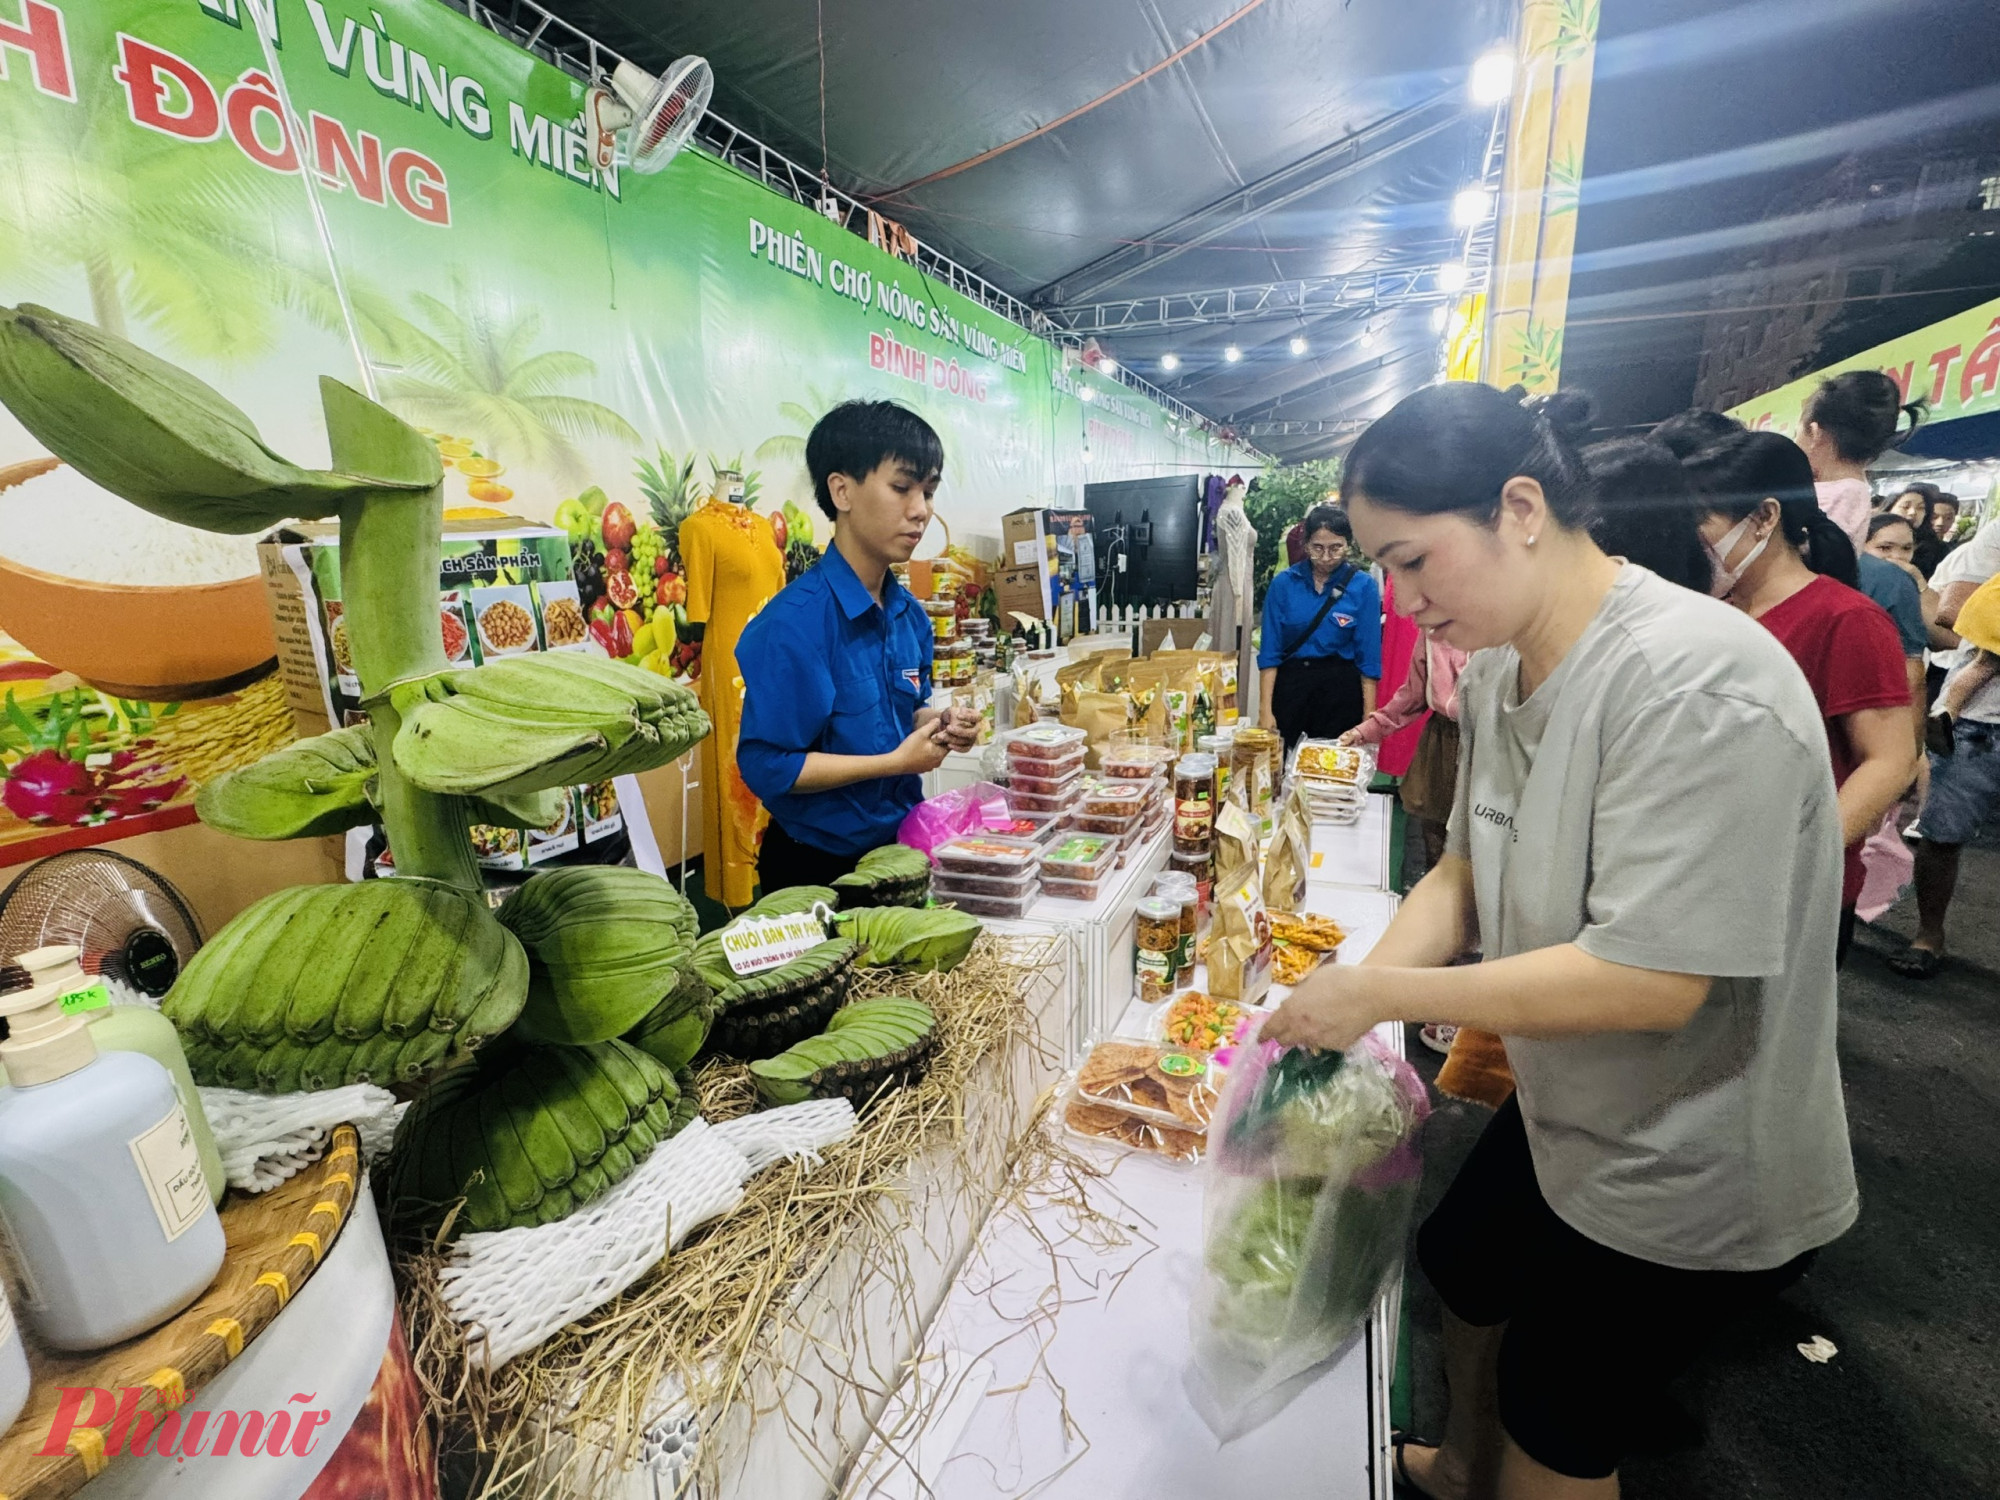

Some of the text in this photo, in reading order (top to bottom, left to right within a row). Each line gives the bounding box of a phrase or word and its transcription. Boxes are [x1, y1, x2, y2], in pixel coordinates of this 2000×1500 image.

[113, 31, 452, 227] ĐÔNG
[304, 0, 493, 141] VÙNG
[749, 217, 823, 289] PHIÊN
[829, 259, 872, 315] CHỢ
[877, 280, 926, 329] NÔNG
[929, 304, 960, 347] SẢN
[963, 322, 998, 363] VÙNG
[870, 328, 927, 384] BÌNH
[466, 551, 497, 572] SẢN
[499, 547, 542, 568] PHẨM
